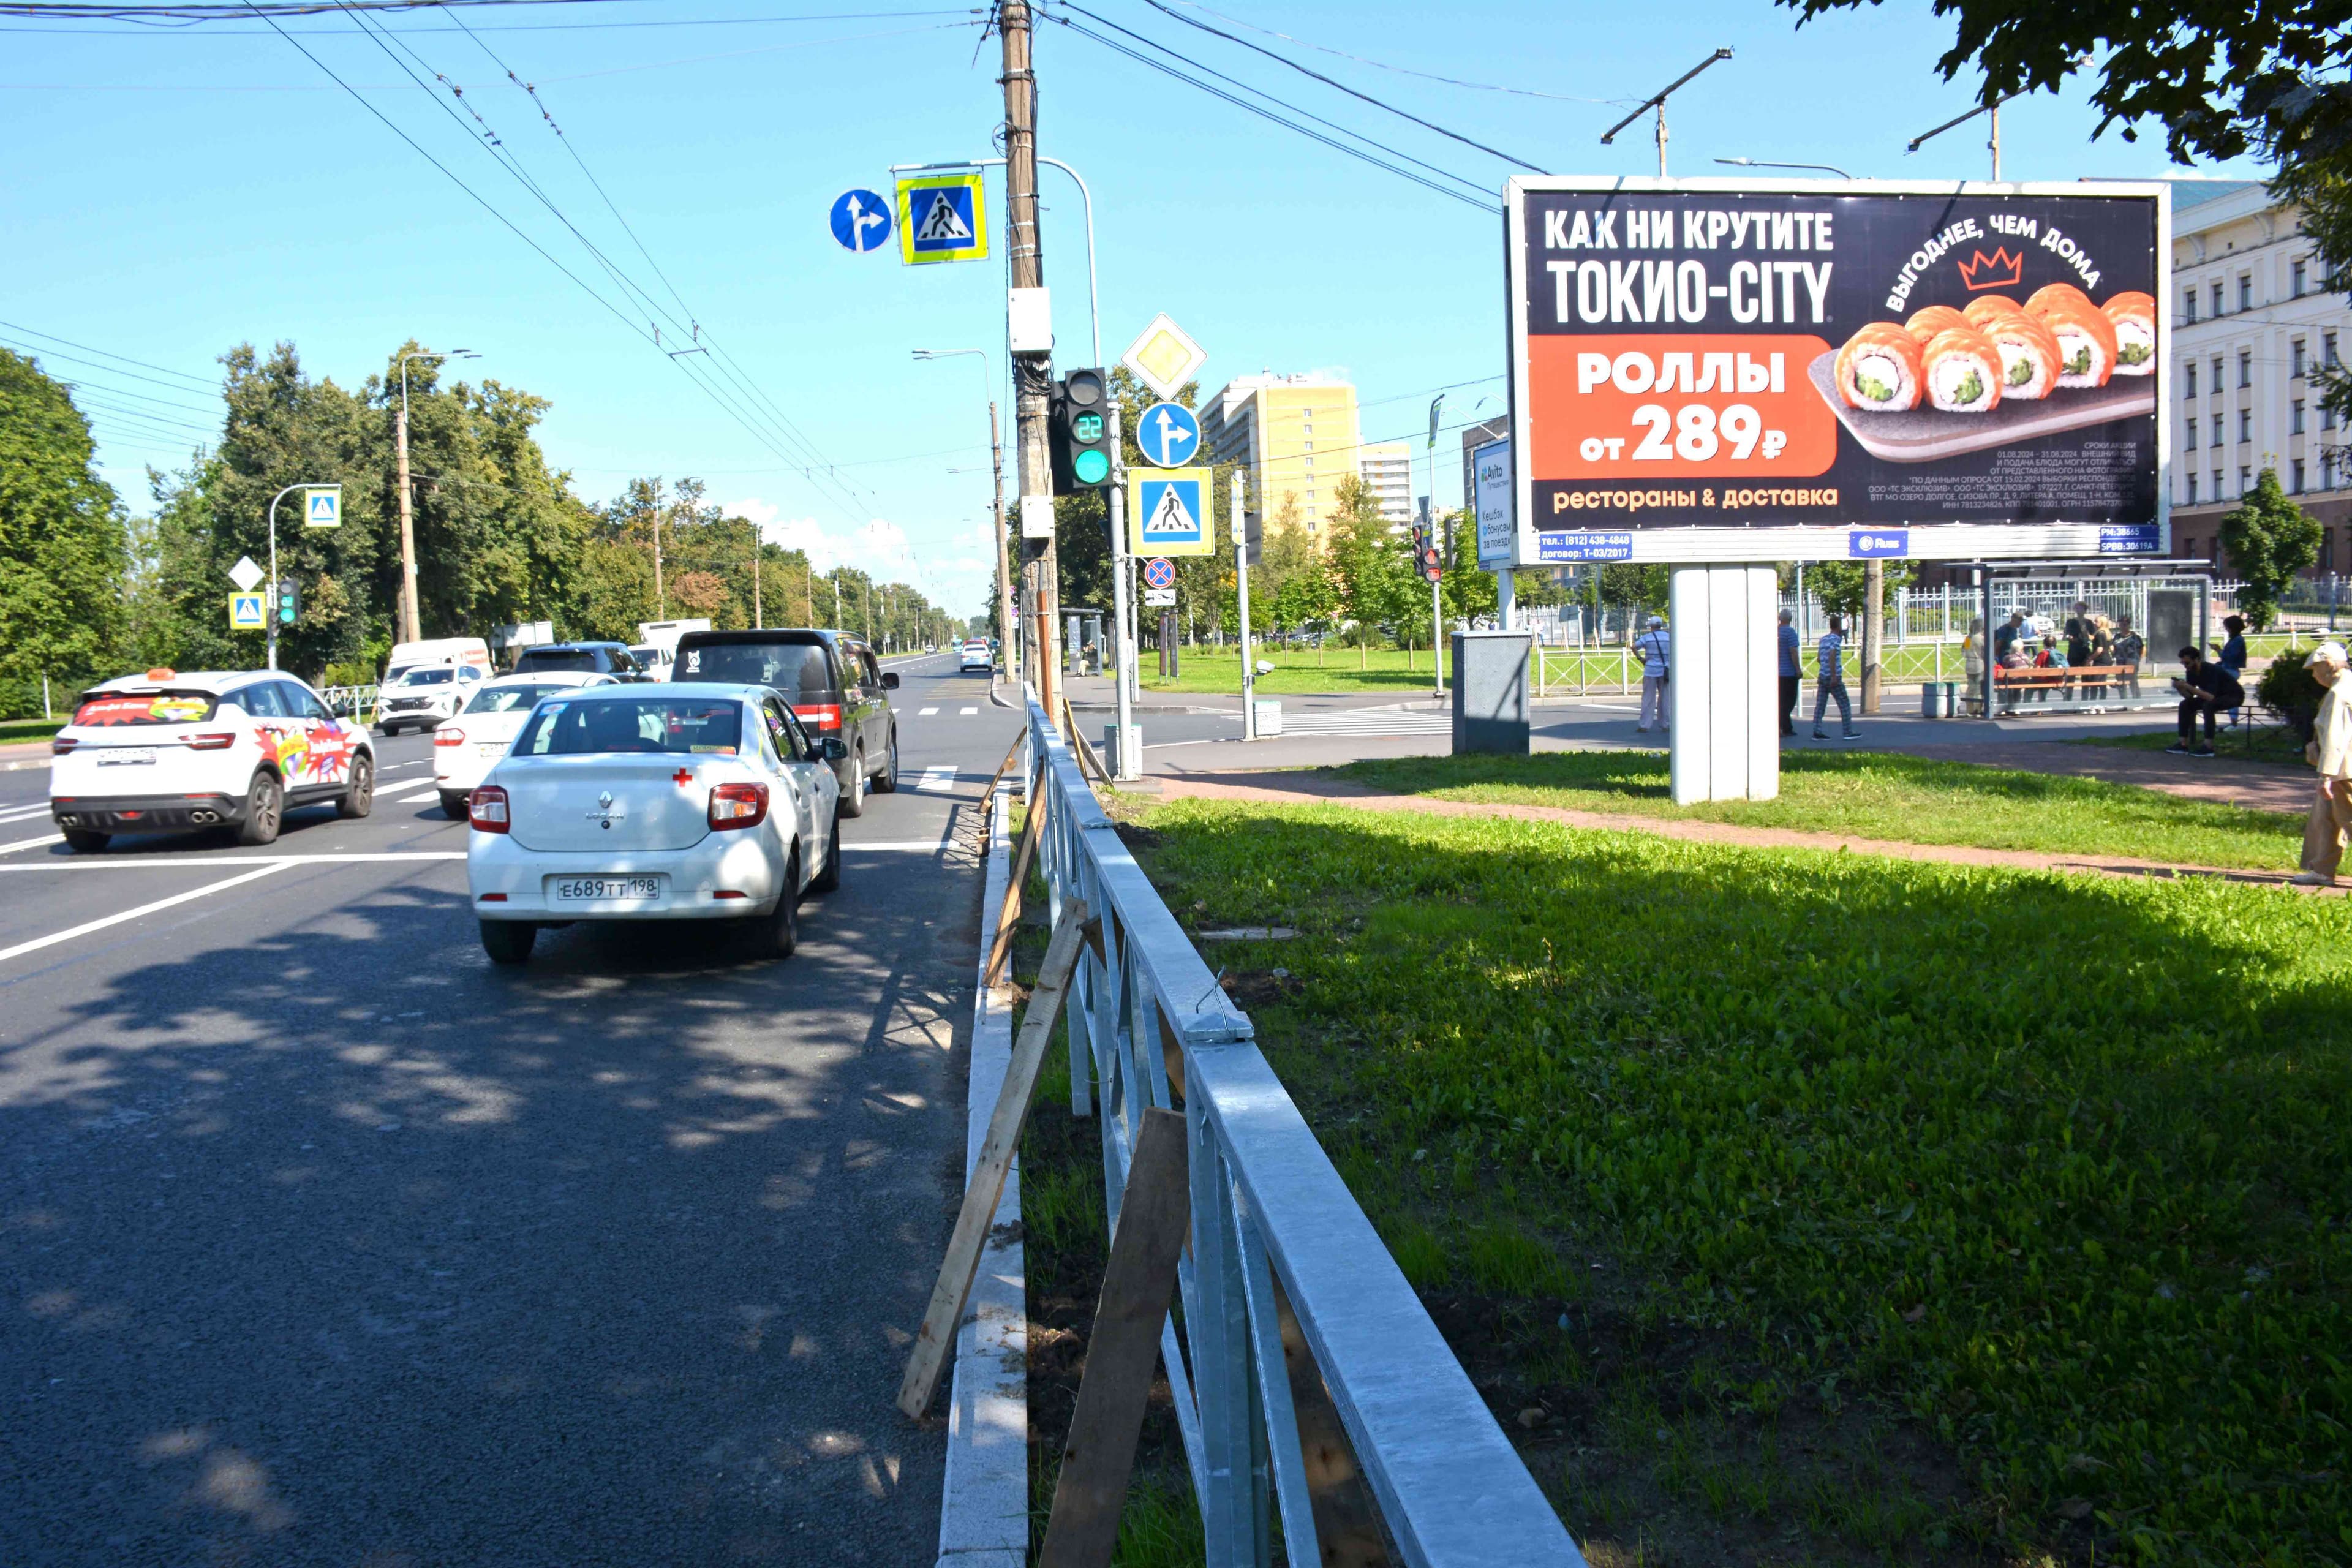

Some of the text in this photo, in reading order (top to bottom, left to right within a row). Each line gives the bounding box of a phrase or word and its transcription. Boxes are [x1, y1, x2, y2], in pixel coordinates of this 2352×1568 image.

[1545, 210, 1833, 250] КАК НИ КРУТИТЕ
[1886, 214, 2101, 312] ВЫГОДНЕЕ, ЧЕМ ДОМА
[1547, 260, 1833, 323] ТОКИО-CITY
[1577, 351, 1785, 394] РОЛЛЫ
[1079, 416, 1102, 439] 22
[1580, 437, 1625, 461] от
[2120, 450, 2136, 459] ВИД
[1487, 464, 1503, 480] Avito
[2001, 467, 2073, 476] ПРЕДСТАВЛЕННОГО
[1553, 488, 1839, 514] рестораны & доставка
[1541, 548, 1628, 560] договор: Т-03/2017
[630, 879, 655, 892] 198
